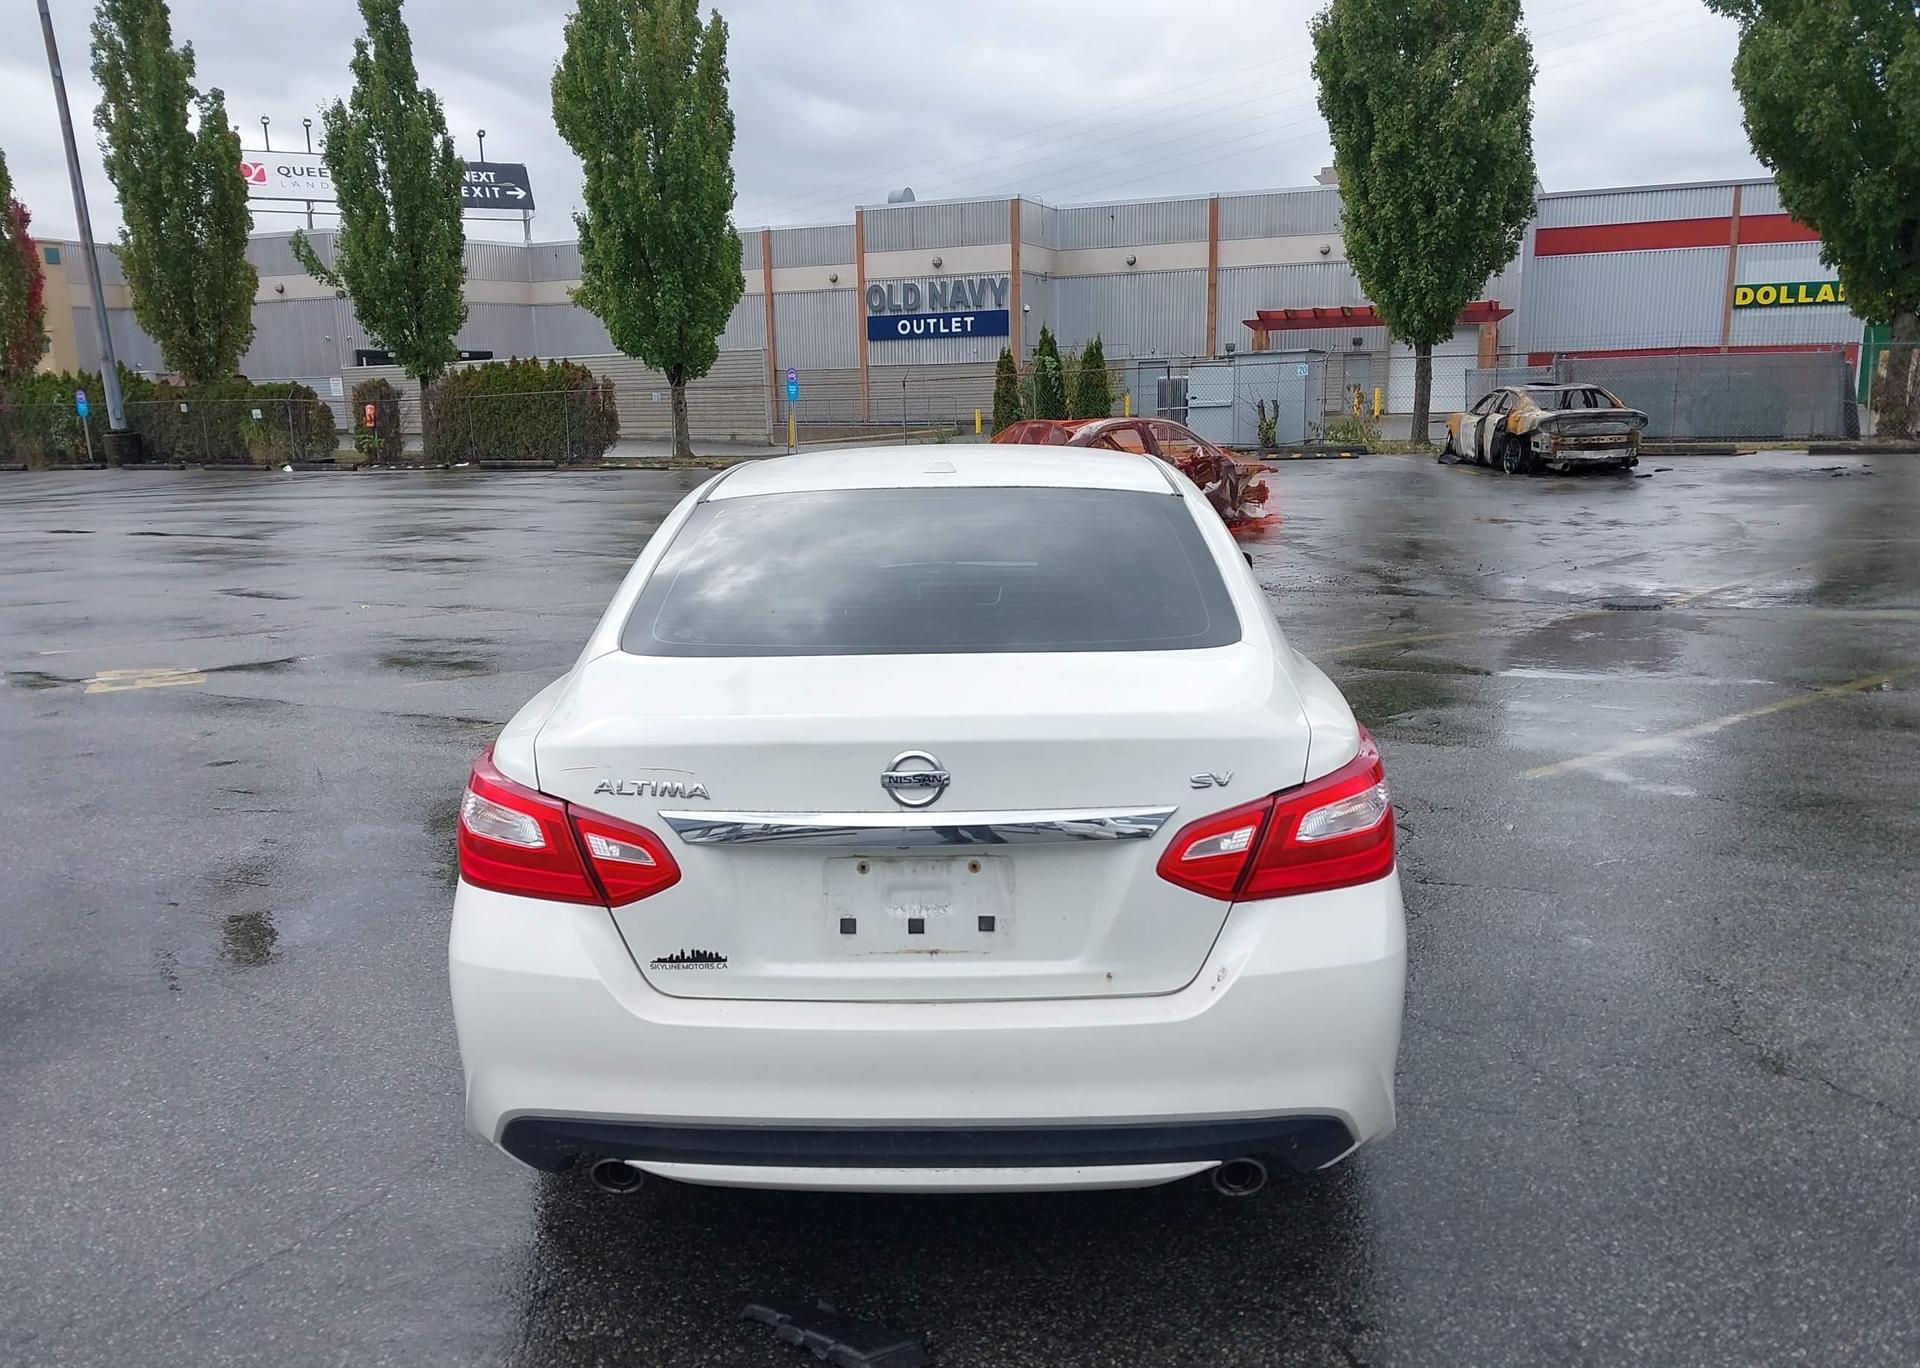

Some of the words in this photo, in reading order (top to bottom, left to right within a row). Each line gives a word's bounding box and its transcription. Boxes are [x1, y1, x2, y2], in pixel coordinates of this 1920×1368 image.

[462, 170, 496, 183] NEXT
[461, 185, 501, 199] EXIT
[866, 282, 921, 312] OLD
[928, 277, 1009, 310] NAVY
[897, 316, 975, 335] OUTLET
[888, 774, 942, 784] NISSAN
[1190, 770, 1233, 789] SV
[593, 778, 711, 800] ALTIMA
